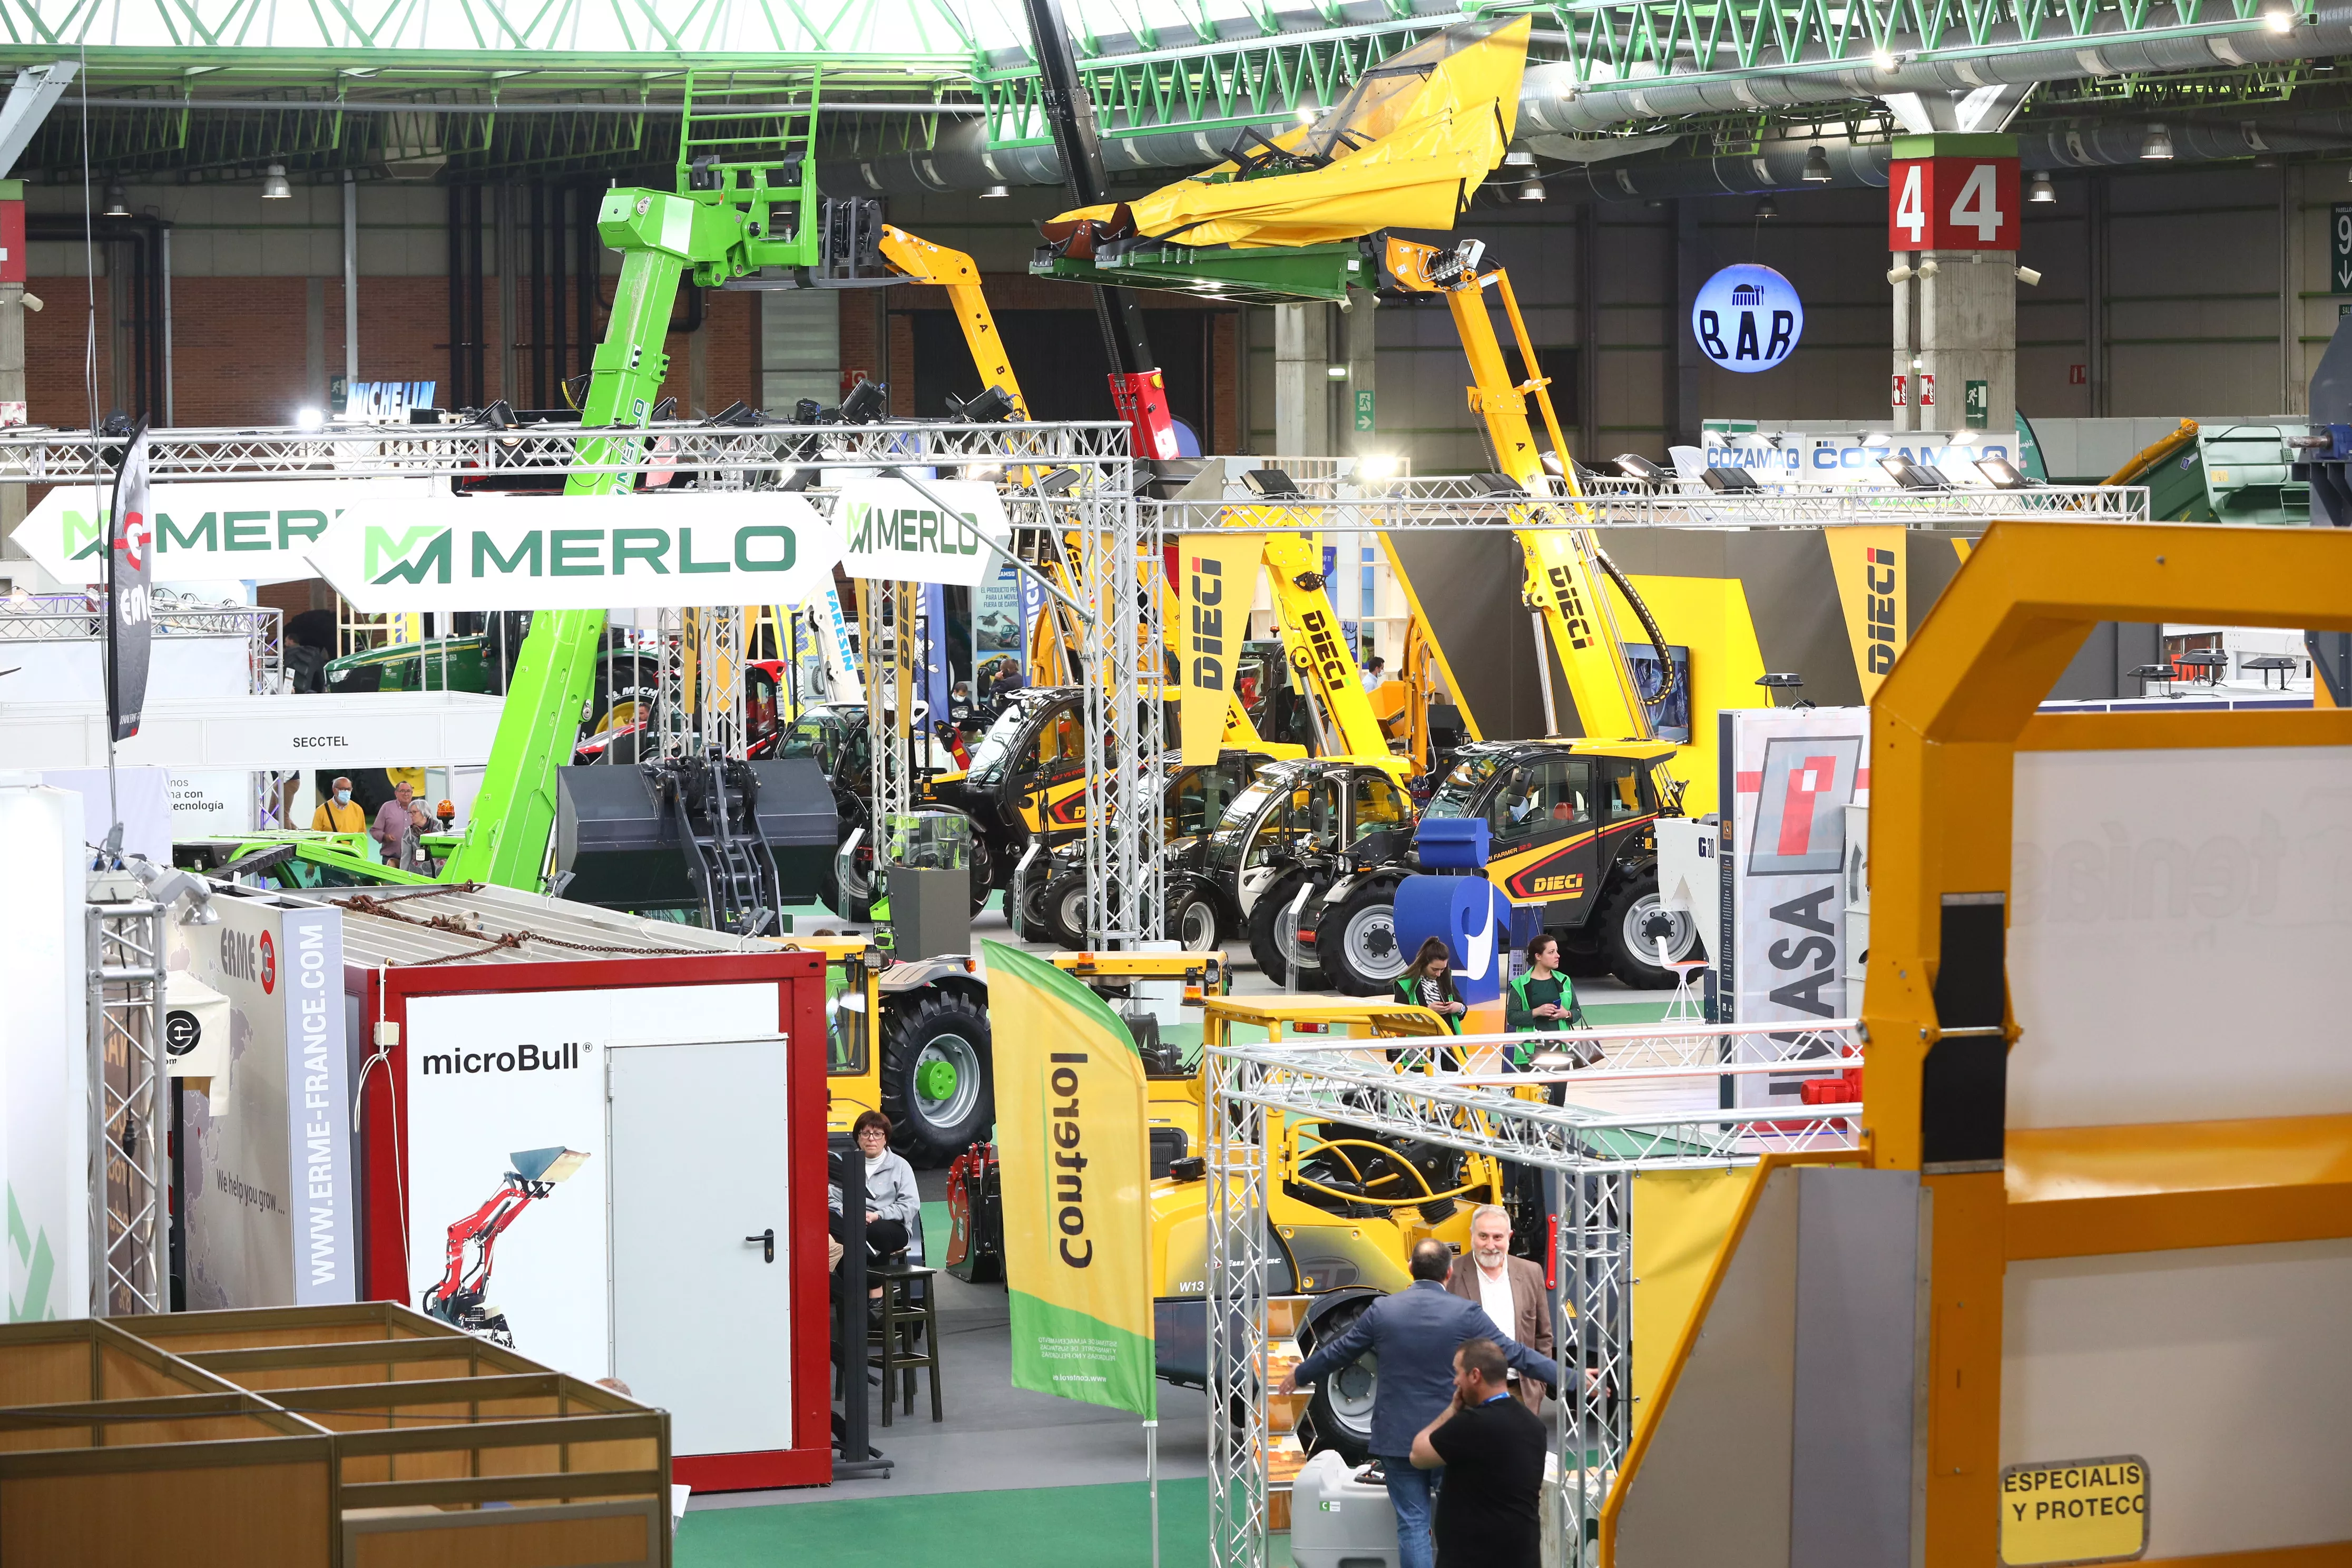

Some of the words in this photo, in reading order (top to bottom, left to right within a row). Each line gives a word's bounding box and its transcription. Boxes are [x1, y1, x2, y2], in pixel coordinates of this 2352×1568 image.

[1896, 166, 1925, 242] 4
[1950, 164, 2003, 241] 4
[2338, 215, 2352, 254] 9
[1699, 310, 1794, 360] BAR
[345, 381, 436, 415] MICHELIN
[1707, 448, 1800, 468] COZAMAQ
[156, 509, 346, 552] MER
[472, 525, 796, 577] MERLO
[878, 508, 978, 556] MERLO
[826, 590, 854, 672] FARESIN
[1192, 556, 1222, 691] DIECI
[1548, 565, 1594, 649] DIECI
[1867, 547, 1895, 675] DIECI
[293, 736, 348, 748] SECCTEL
[1494, 847, 1517, 860] FARMER
[1534, 874, 1583, 893] DIECI
[221, 927, 256, 983] ERME
[299, 925, 336, 1286] WWW.ERME-FRANCE.COM
[217, 1169, 228, 1193] We
[228, 1172, 243, 1204] help
[244, 1184, 258, 1206] you
[259, 1191, 277, 1213] grow
[2004, 1465, 2140, 1493] ESPECIALIS
[2012, 1504, 2026, 1521] Y
